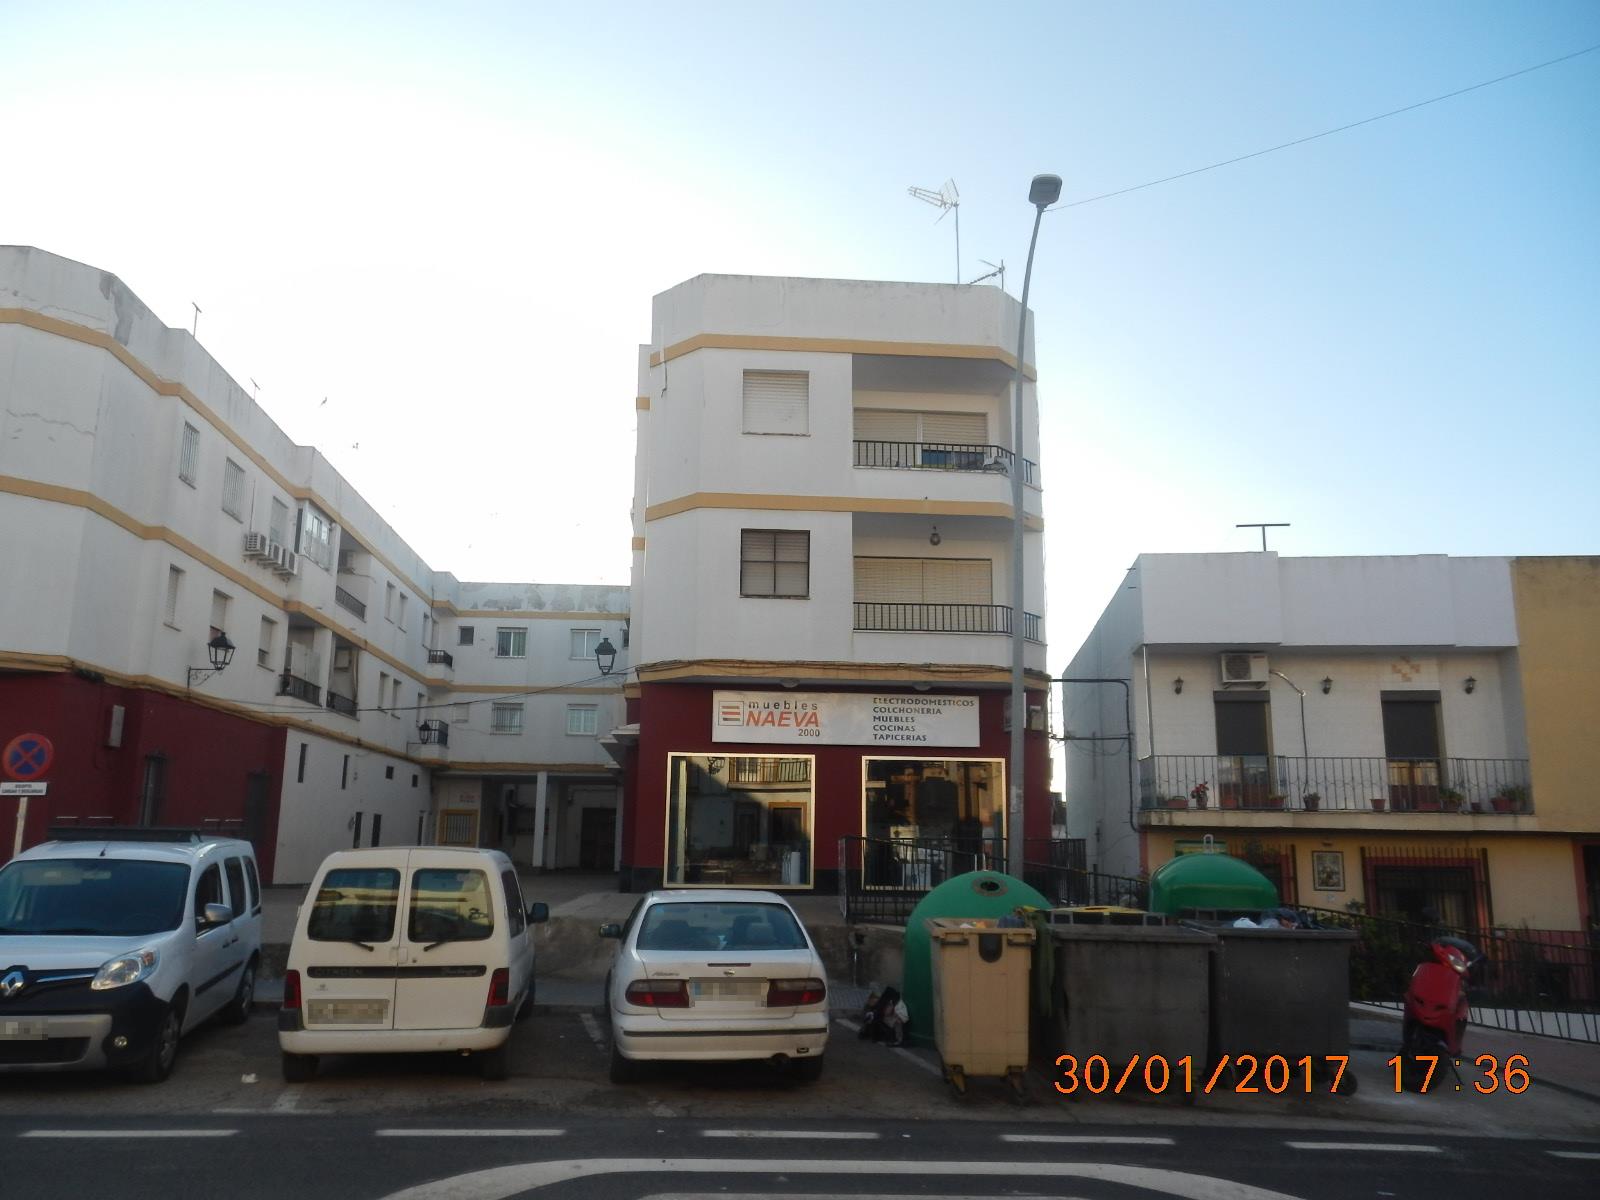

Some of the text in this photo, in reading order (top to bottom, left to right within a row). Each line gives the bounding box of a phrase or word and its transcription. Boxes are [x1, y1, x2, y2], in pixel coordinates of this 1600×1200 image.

[748, 700, 818, 710] muebles
[873, 697, 975, 707] ELECTRODOMESTICOS
[873, 706, 942, 715] COLCHONERIA
[745, 710, 820, 728] NAEVA
[873, 715, 915, 723] MUEBLES
[798, 728, 821, 737] 2000
[873, 724, 916, 732] COCINAS
[873, 733, 927, 742] TAPICERIAS
